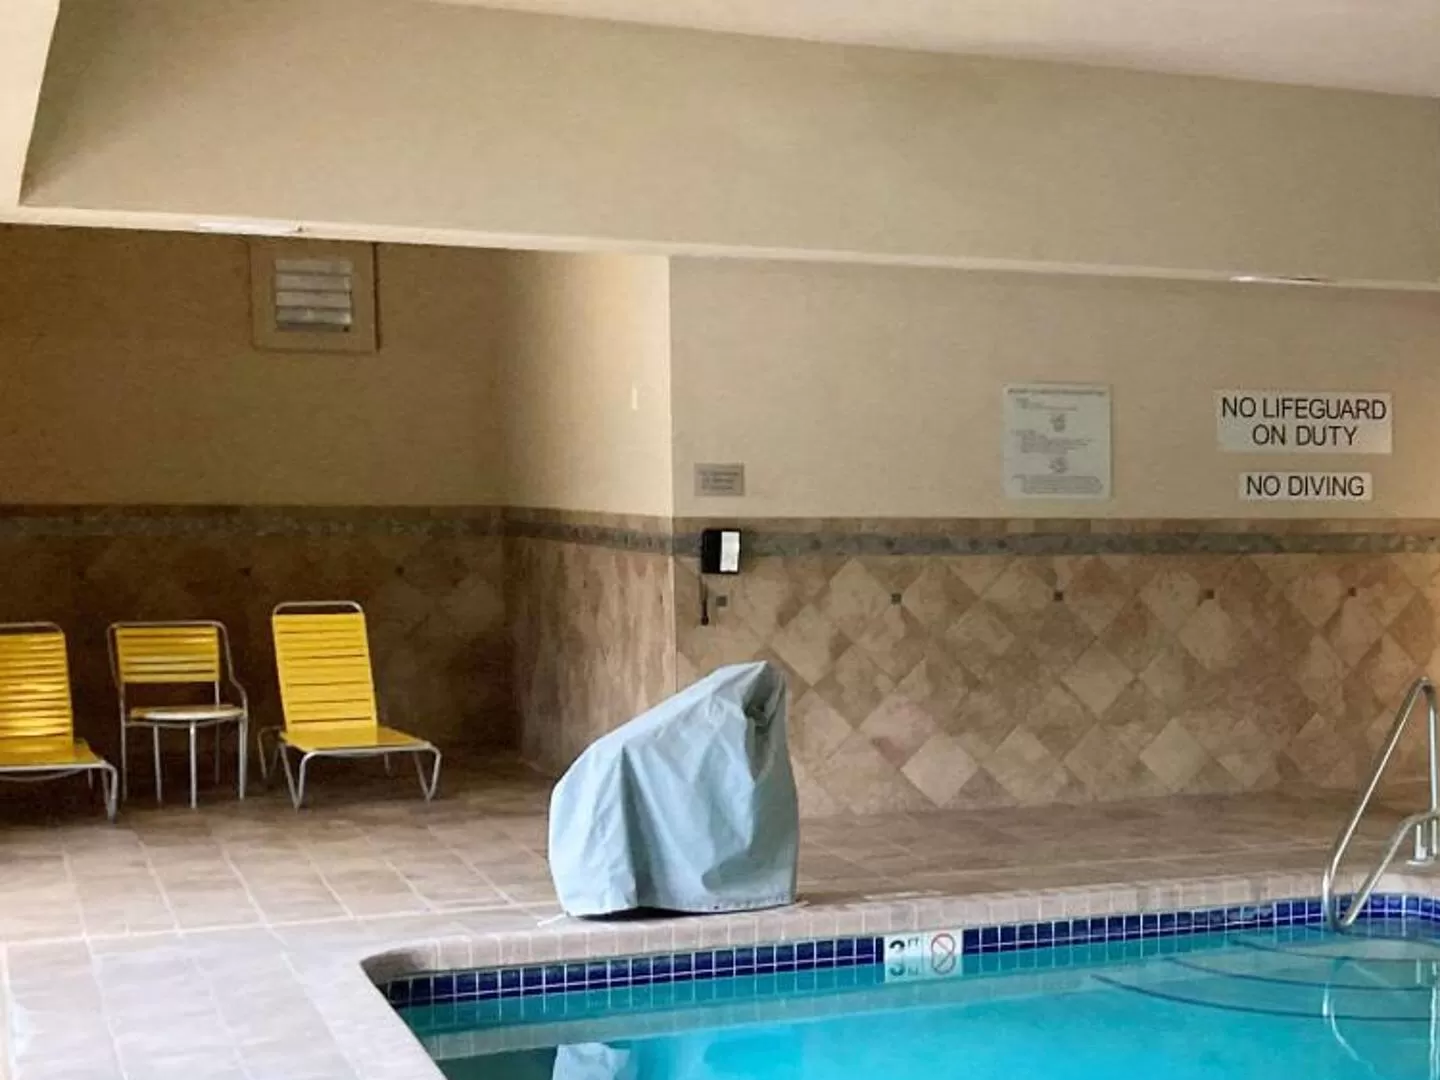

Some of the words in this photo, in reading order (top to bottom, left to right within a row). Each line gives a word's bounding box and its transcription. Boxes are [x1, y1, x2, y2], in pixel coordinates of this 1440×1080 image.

[1221, 396, 1257, 418] NO
[1262, 397, 1388, 420] LIFEGUARD
[1252, 423, 1287, 446] ON
[1296, 424, 1359, 447] DUTY
[1246, 475, 1281, 497] NO
[1287, 475, 1365, 497] DIVING
